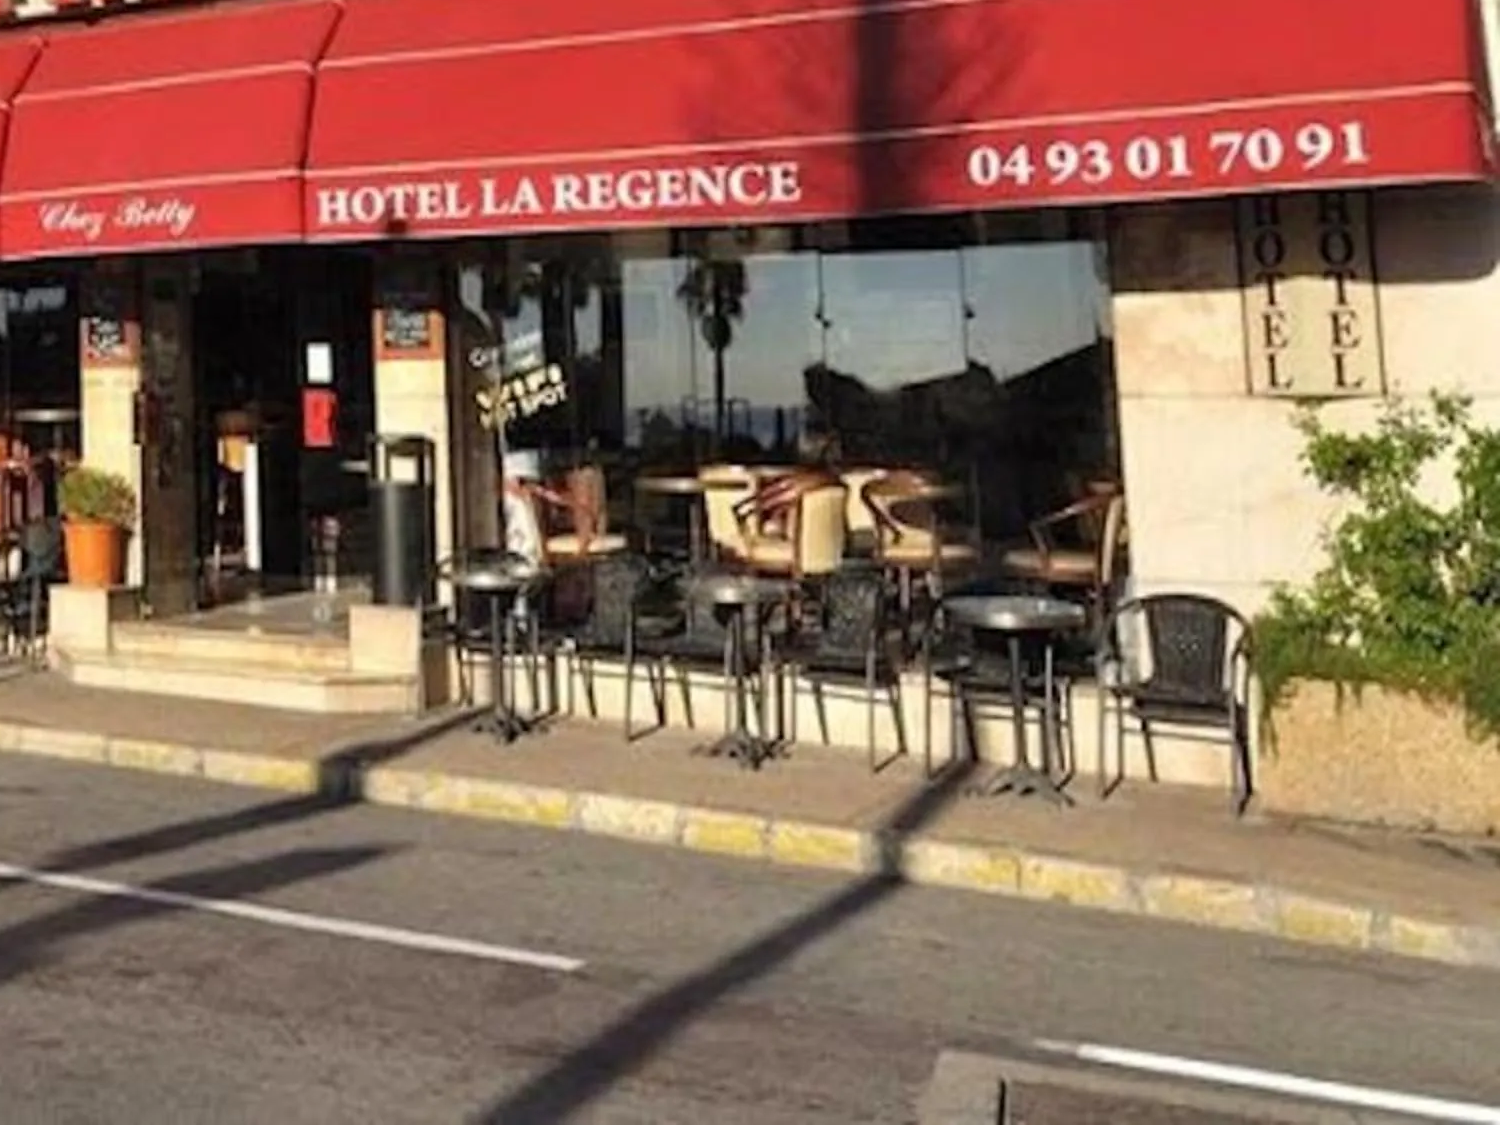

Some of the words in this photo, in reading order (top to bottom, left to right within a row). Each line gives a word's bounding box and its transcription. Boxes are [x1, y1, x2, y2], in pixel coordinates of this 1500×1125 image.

[968, 145, 1035, 186] 04
[1045, 141, 1113, 183] 93
[1124, 137, 1192, 179] 01
[1209, 130, 1284, 174] 70
[1296, 122, 1370, 169] 91
[40, 200, 106, 242] Chez
[112, 195, 196, 238] Betty
[317, 181, 471, 225] HOTEL
[479, 177, 545, 215] LA
[552, 161, 802, 212] REGENCE
